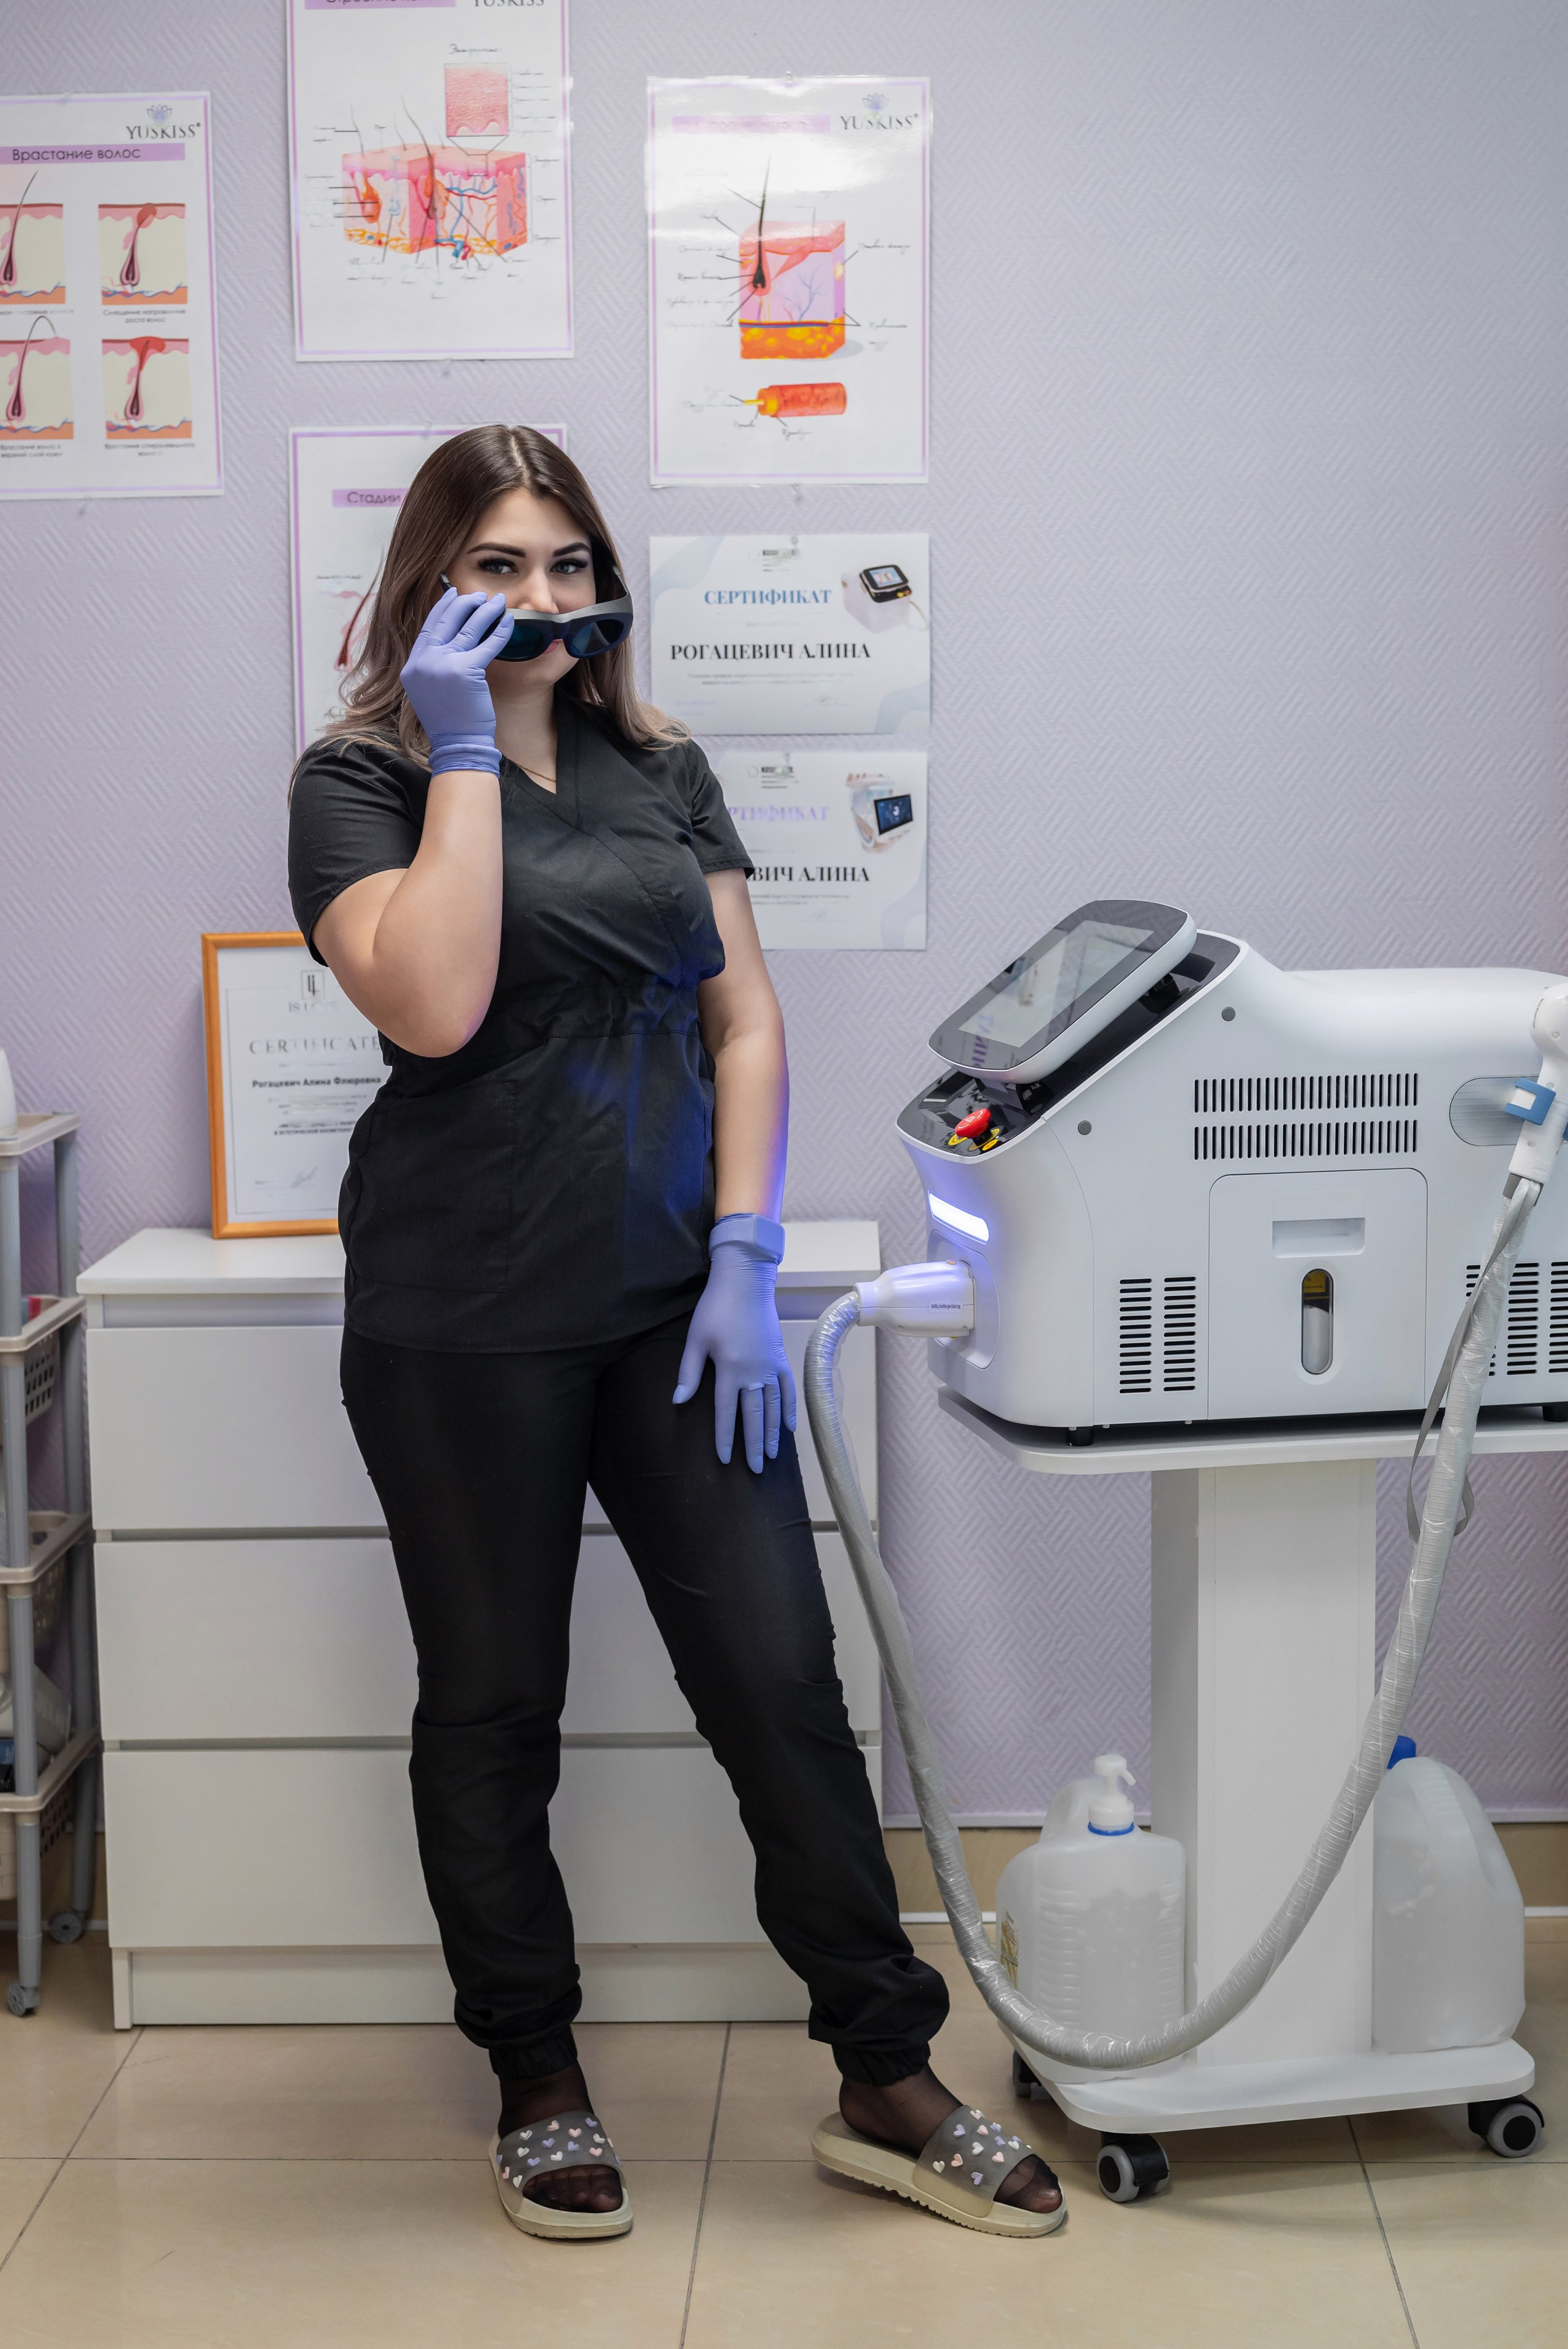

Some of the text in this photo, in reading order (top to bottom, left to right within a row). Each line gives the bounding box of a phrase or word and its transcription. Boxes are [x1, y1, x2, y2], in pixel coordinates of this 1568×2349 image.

[12, 148, 141, 162] Врастание волос
[347, 491, 401, 504] Стадии
[704, 589, 831, 605] СЕРТИФИКАТ
[671, 643, 870, 661] РОГАЦЕВИЧ АЛИНА
[728, 806, 829, 821] РТИФИКАТ
[799, 867, 870, 881] АЛИНА
